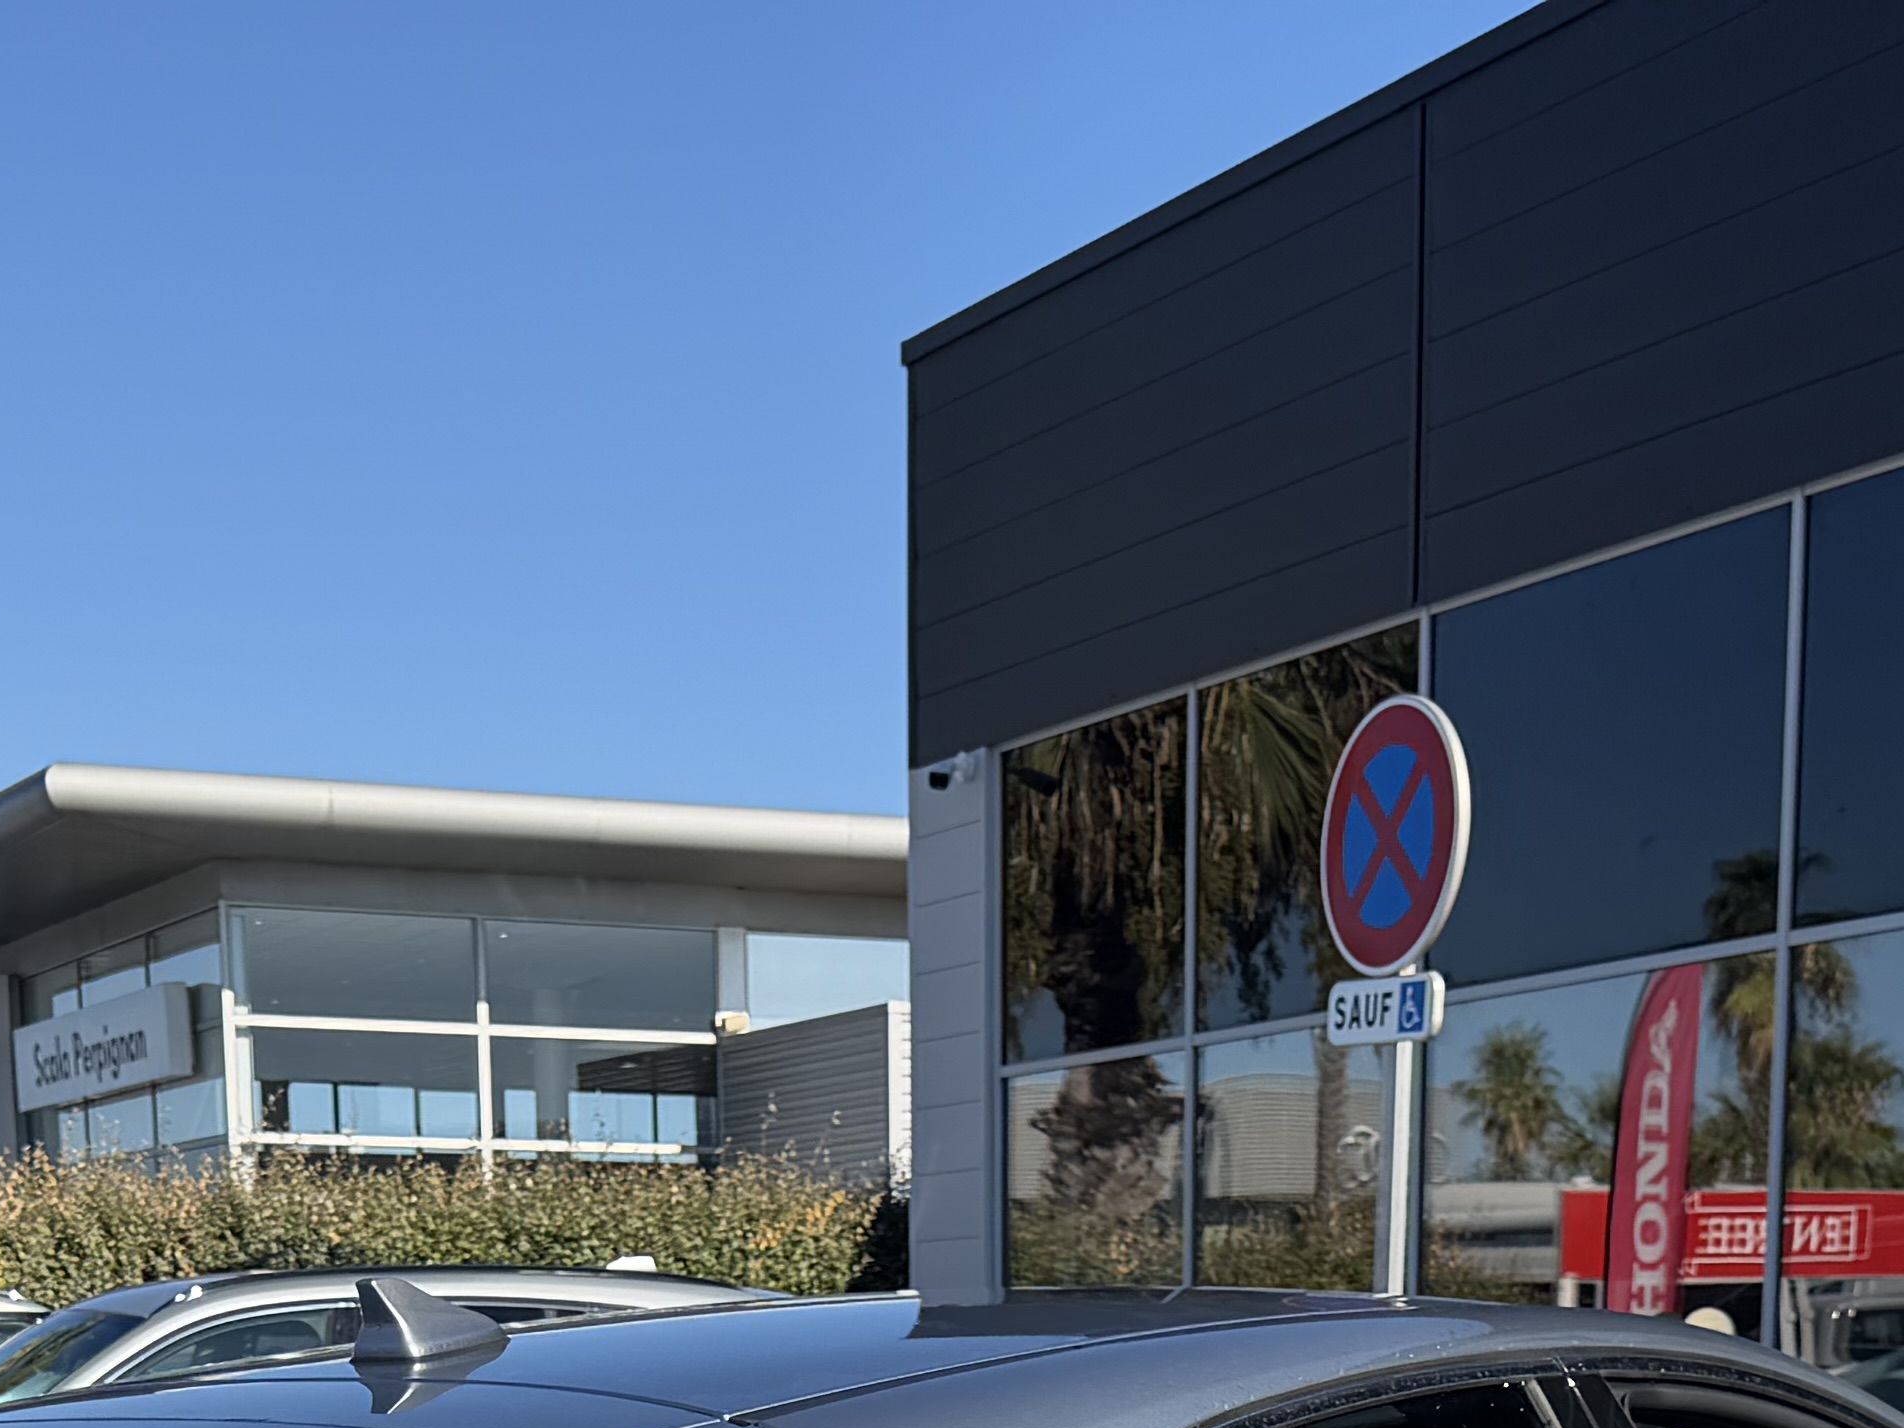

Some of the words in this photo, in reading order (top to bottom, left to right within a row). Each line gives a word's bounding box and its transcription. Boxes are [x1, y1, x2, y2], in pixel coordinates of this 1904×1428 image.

[1334, 992, 1393, 1030] SAUF
[33, 1035, 72, 1087] Scala
[72, 1025, 147, 1083] Perpignan
[1628, 999, 1679, 1315] HONDA
